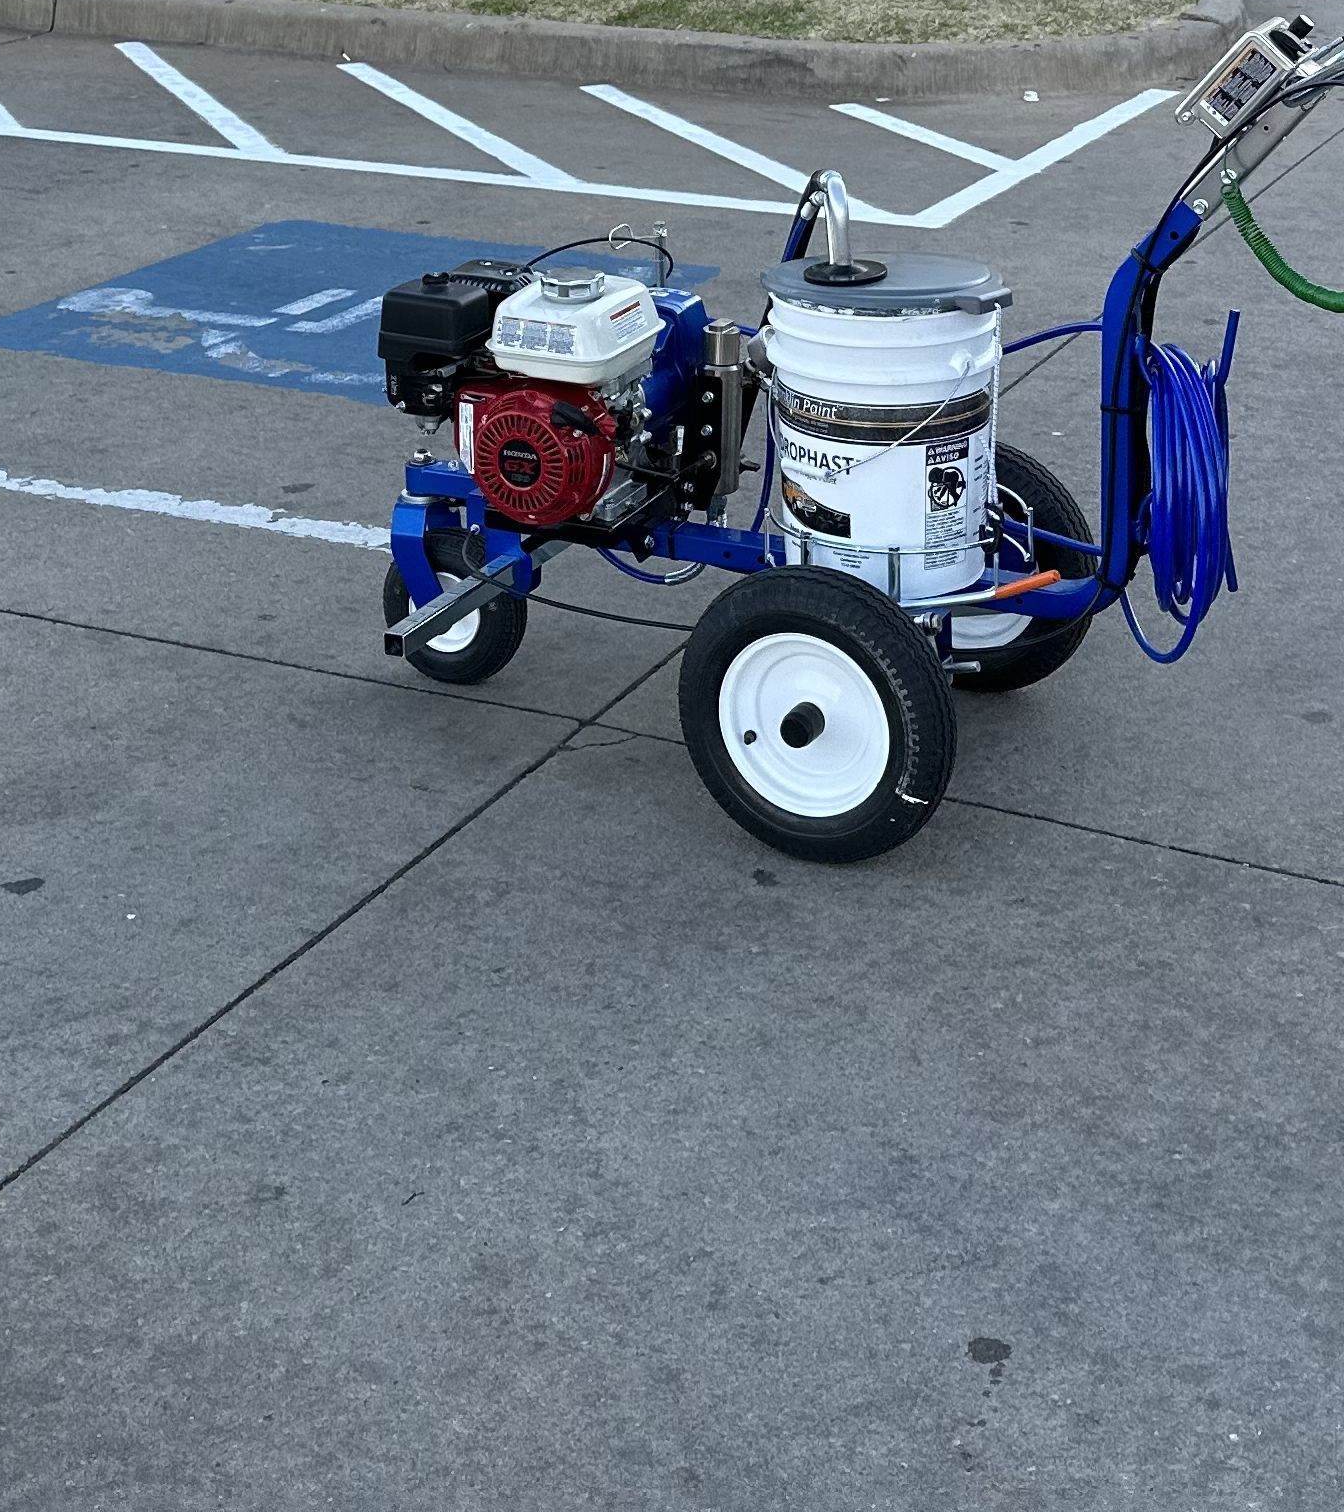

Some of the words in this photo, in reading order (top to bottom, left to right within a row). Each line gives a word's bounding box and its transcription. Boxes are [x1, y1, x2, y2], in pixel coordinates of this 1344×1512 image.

[803, 397, 838, 420] Paint
[503, 449, 538, 461] HONDA
[936, 451, 960, 463] AVISO
[504, 459, 538, 475] GX
